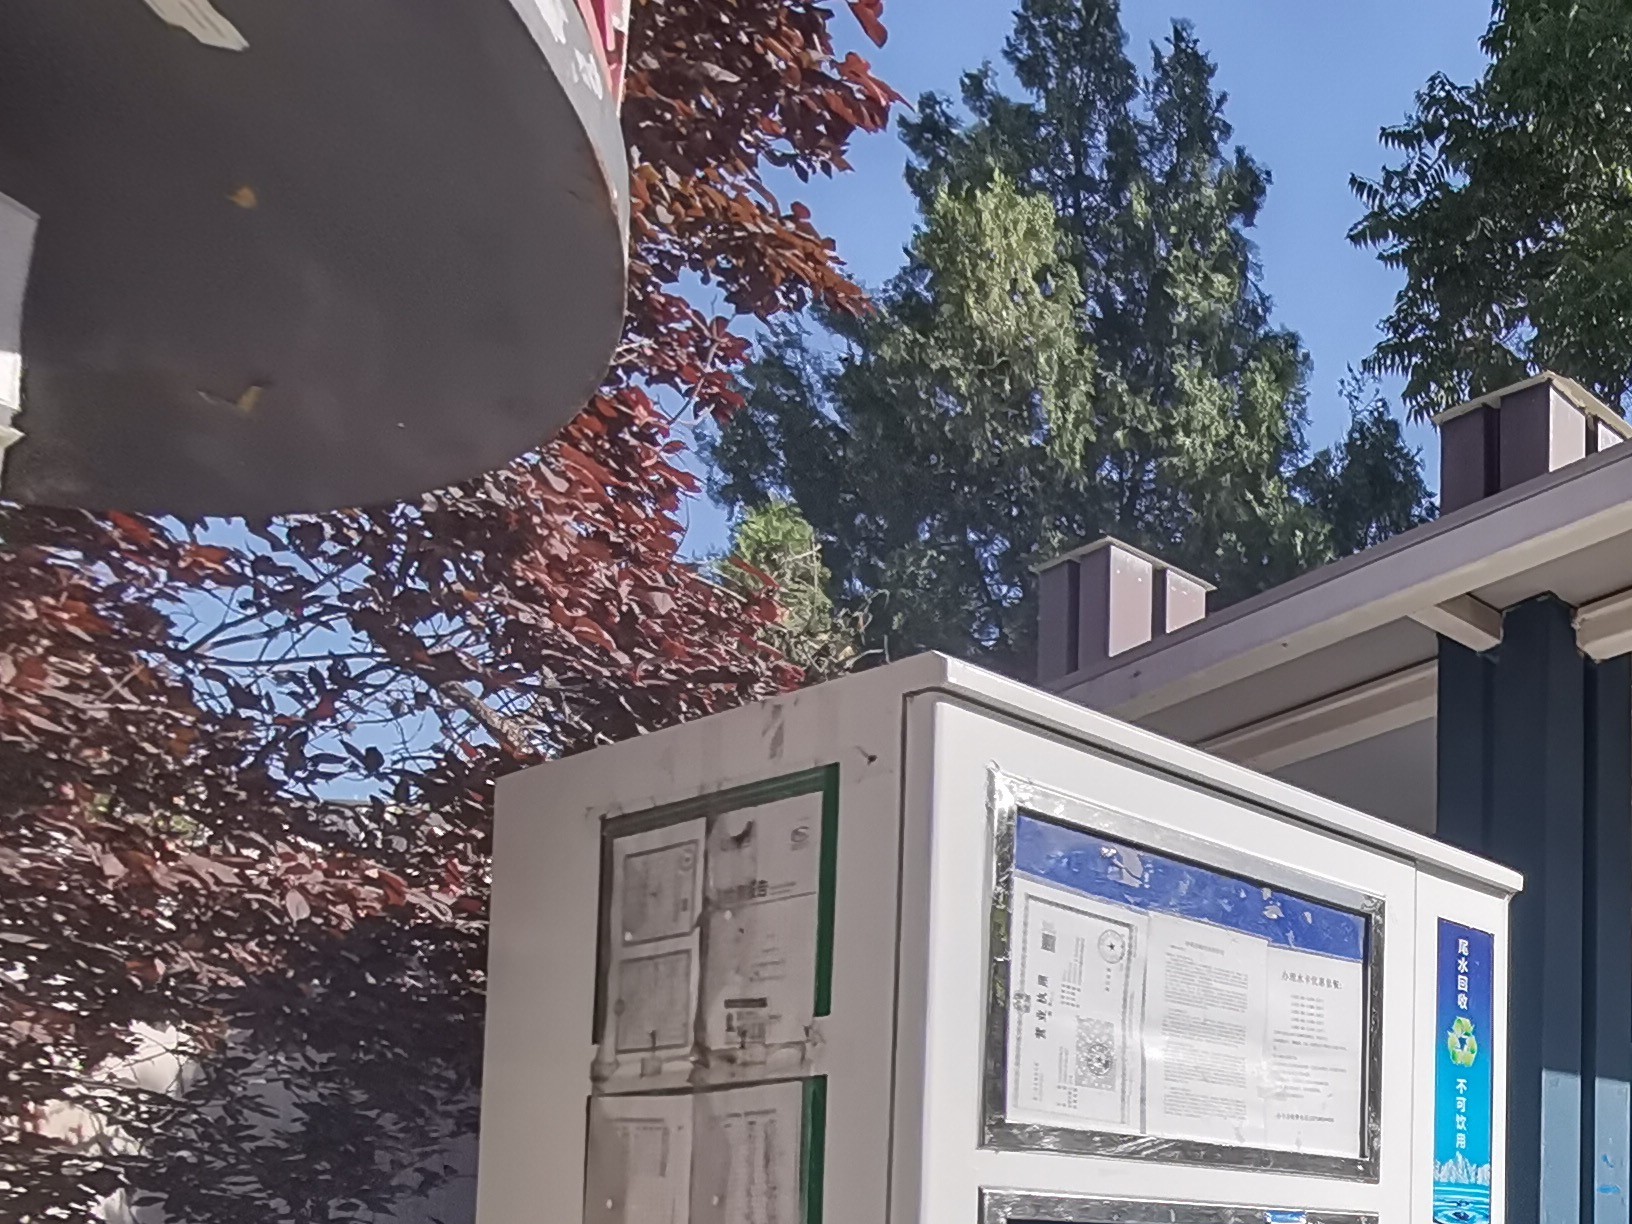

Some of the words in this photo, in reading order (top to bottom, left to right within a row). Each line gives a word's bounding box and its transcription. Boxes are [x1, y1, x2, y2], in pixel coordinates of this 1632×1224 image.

[1457, 938, 1470, 1010] 尾水回收
[1455, 1078, 1468, 1149] 不可饮用
